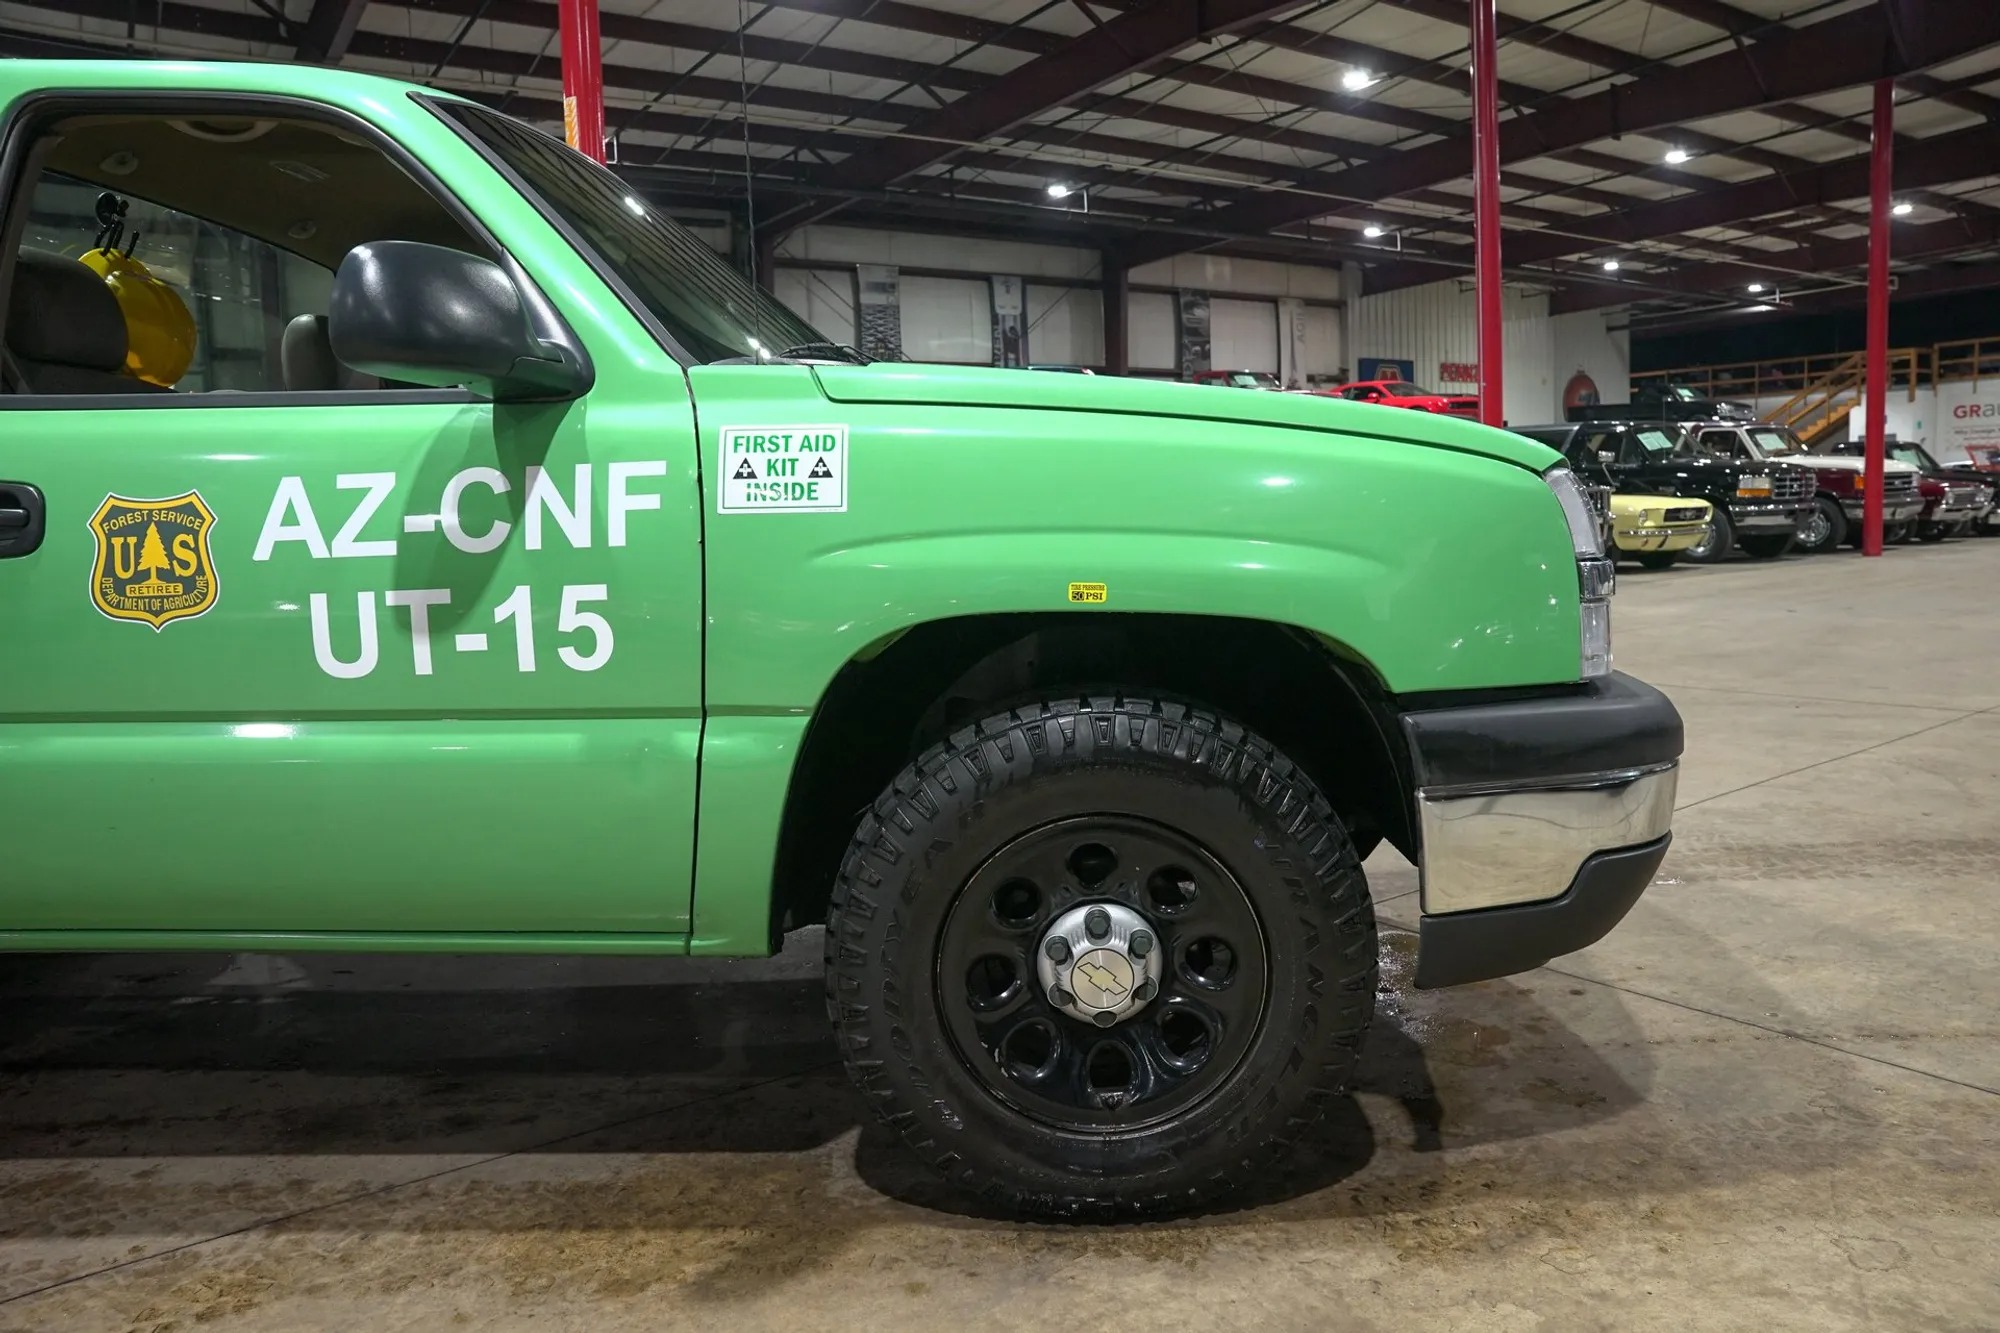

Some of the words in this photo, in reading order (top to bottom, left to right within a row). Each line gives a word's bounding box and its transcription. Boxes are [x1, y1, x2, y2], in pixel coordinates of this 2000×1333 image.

[733, 434, 793, 454] FIRST
[798, 434, 836, 453] AID
[766, 458, 799, 477] KIT
[746, 482, 819, 502] INSIDE
[252, 460, 667, 562] AZ-CNF
[102, 510, 150, 533] FOREST
[152, 510, 203, 531] SERVICE
[102, 577, 150, 611] DEPARTMENT
[151, 598, 162, 611] OF
[163, 575, 208, 611] AGRICULTURE
[129, 584, 180, 595] RETIREE
[1072, 591, 1084, 600] 50
[1085, 592, 1103, 600] PSI
[309, 583, 614, 679] UT-15
